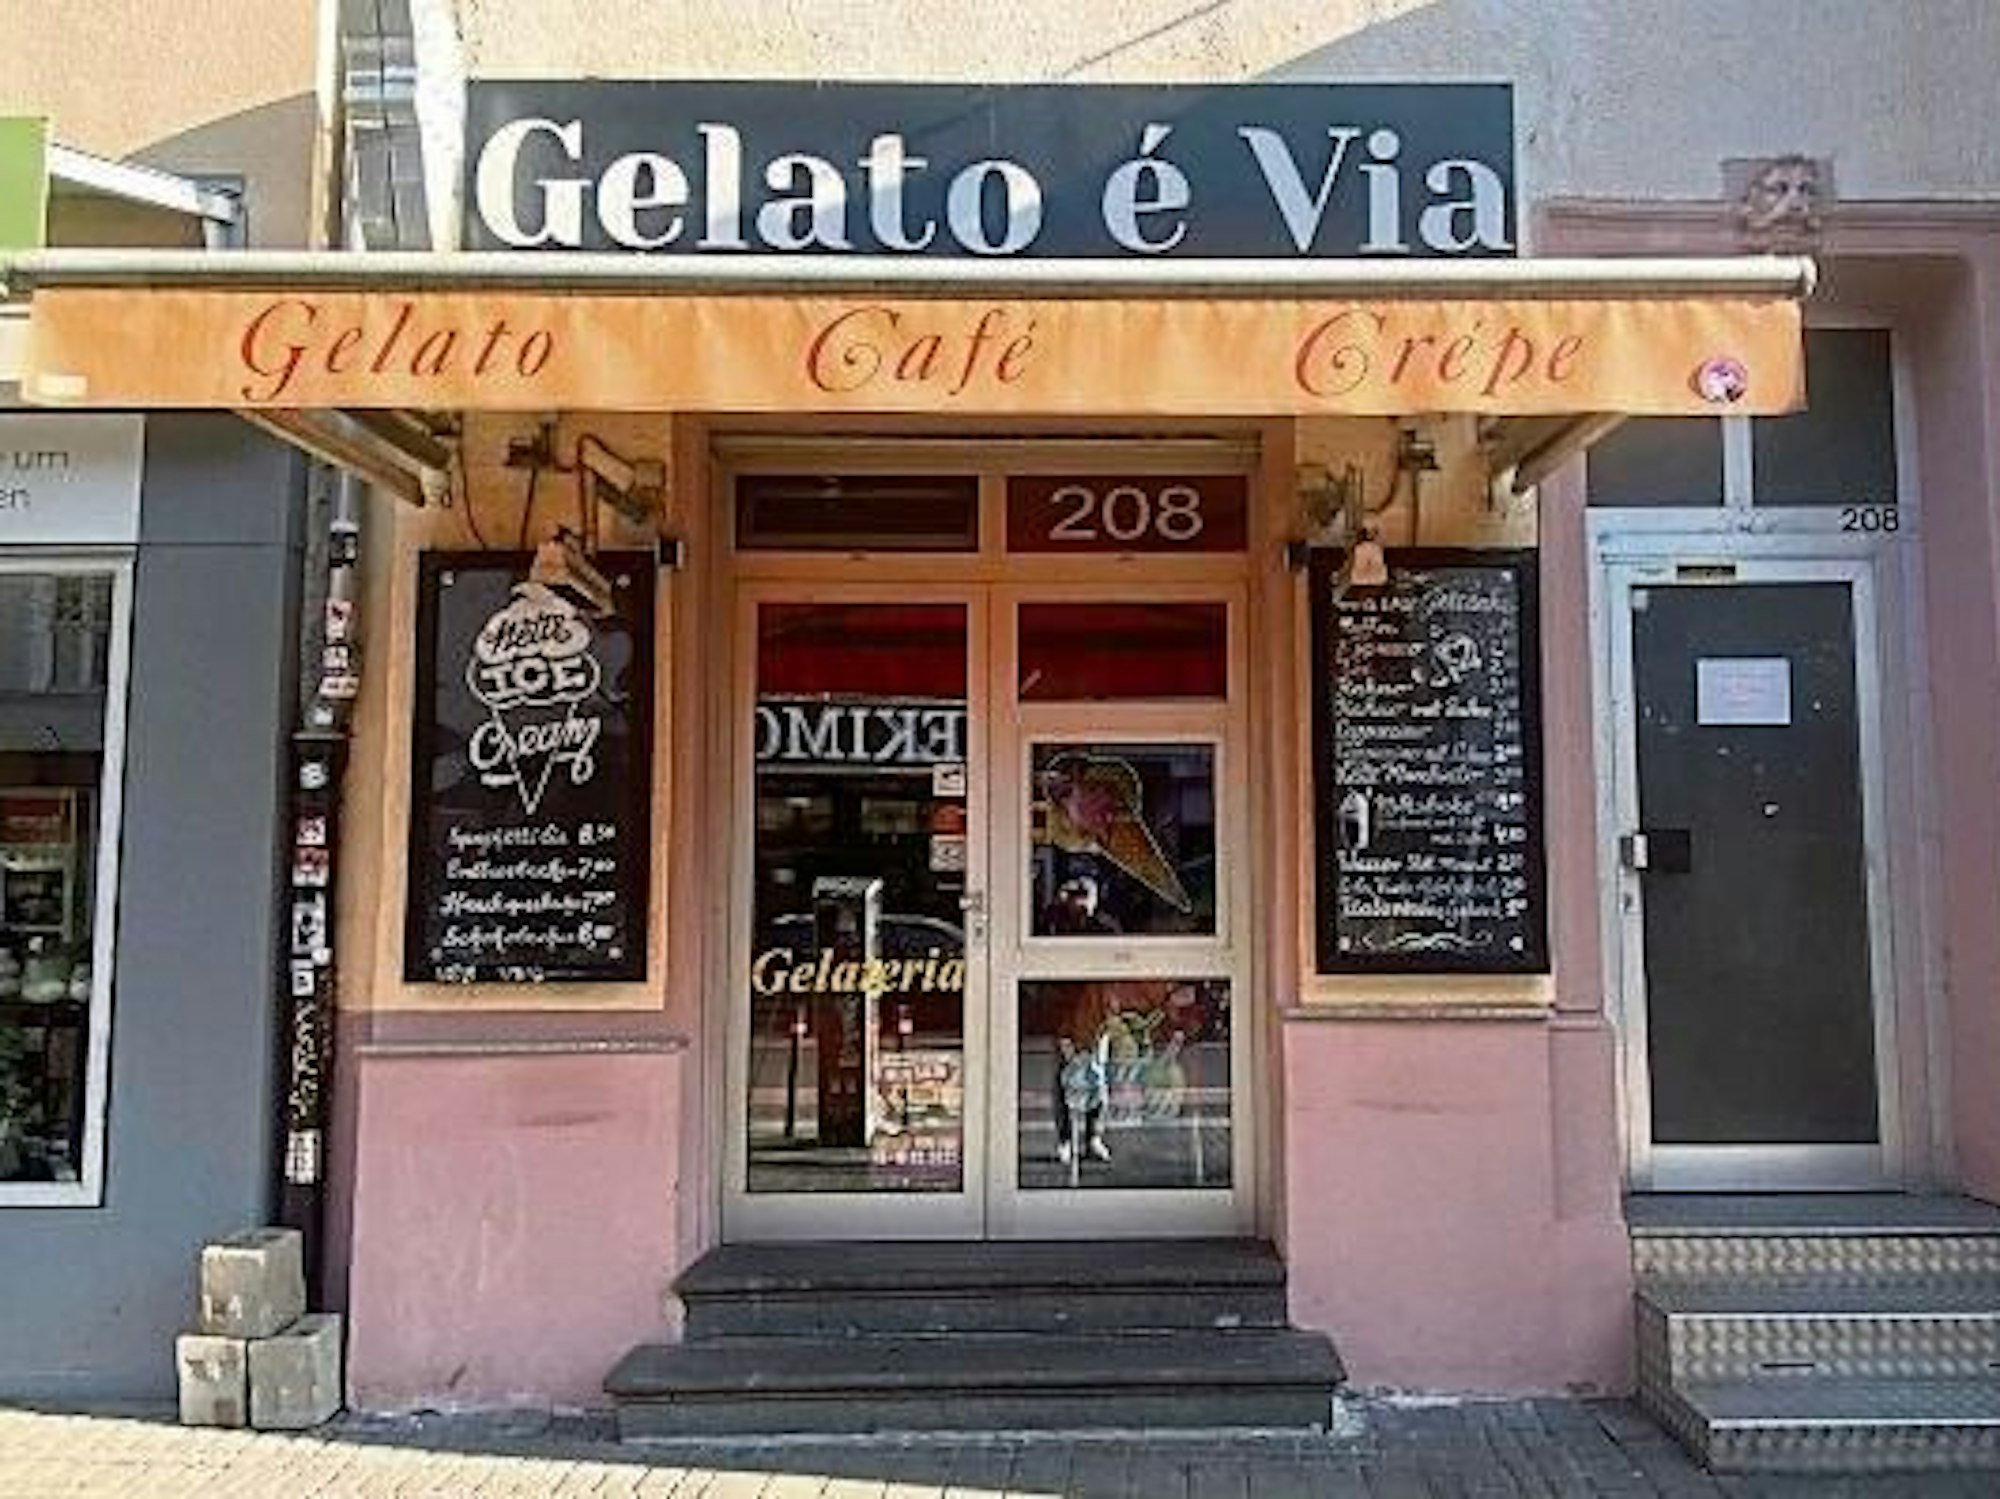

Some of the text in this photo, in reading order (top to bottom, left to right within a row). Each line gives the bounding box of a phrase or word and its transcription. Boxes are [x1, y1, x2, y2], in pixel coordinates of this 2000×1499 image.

[475, 118, 1515, 255] Gelato é Via
[241, 300, 554, 400] Gelato
[804, 307, 1036, 395] Café
[1048, 486, 1205, 541] 208
[1841, 507, 1899, 532] 208
[480, 655, 587, 700] ICE
